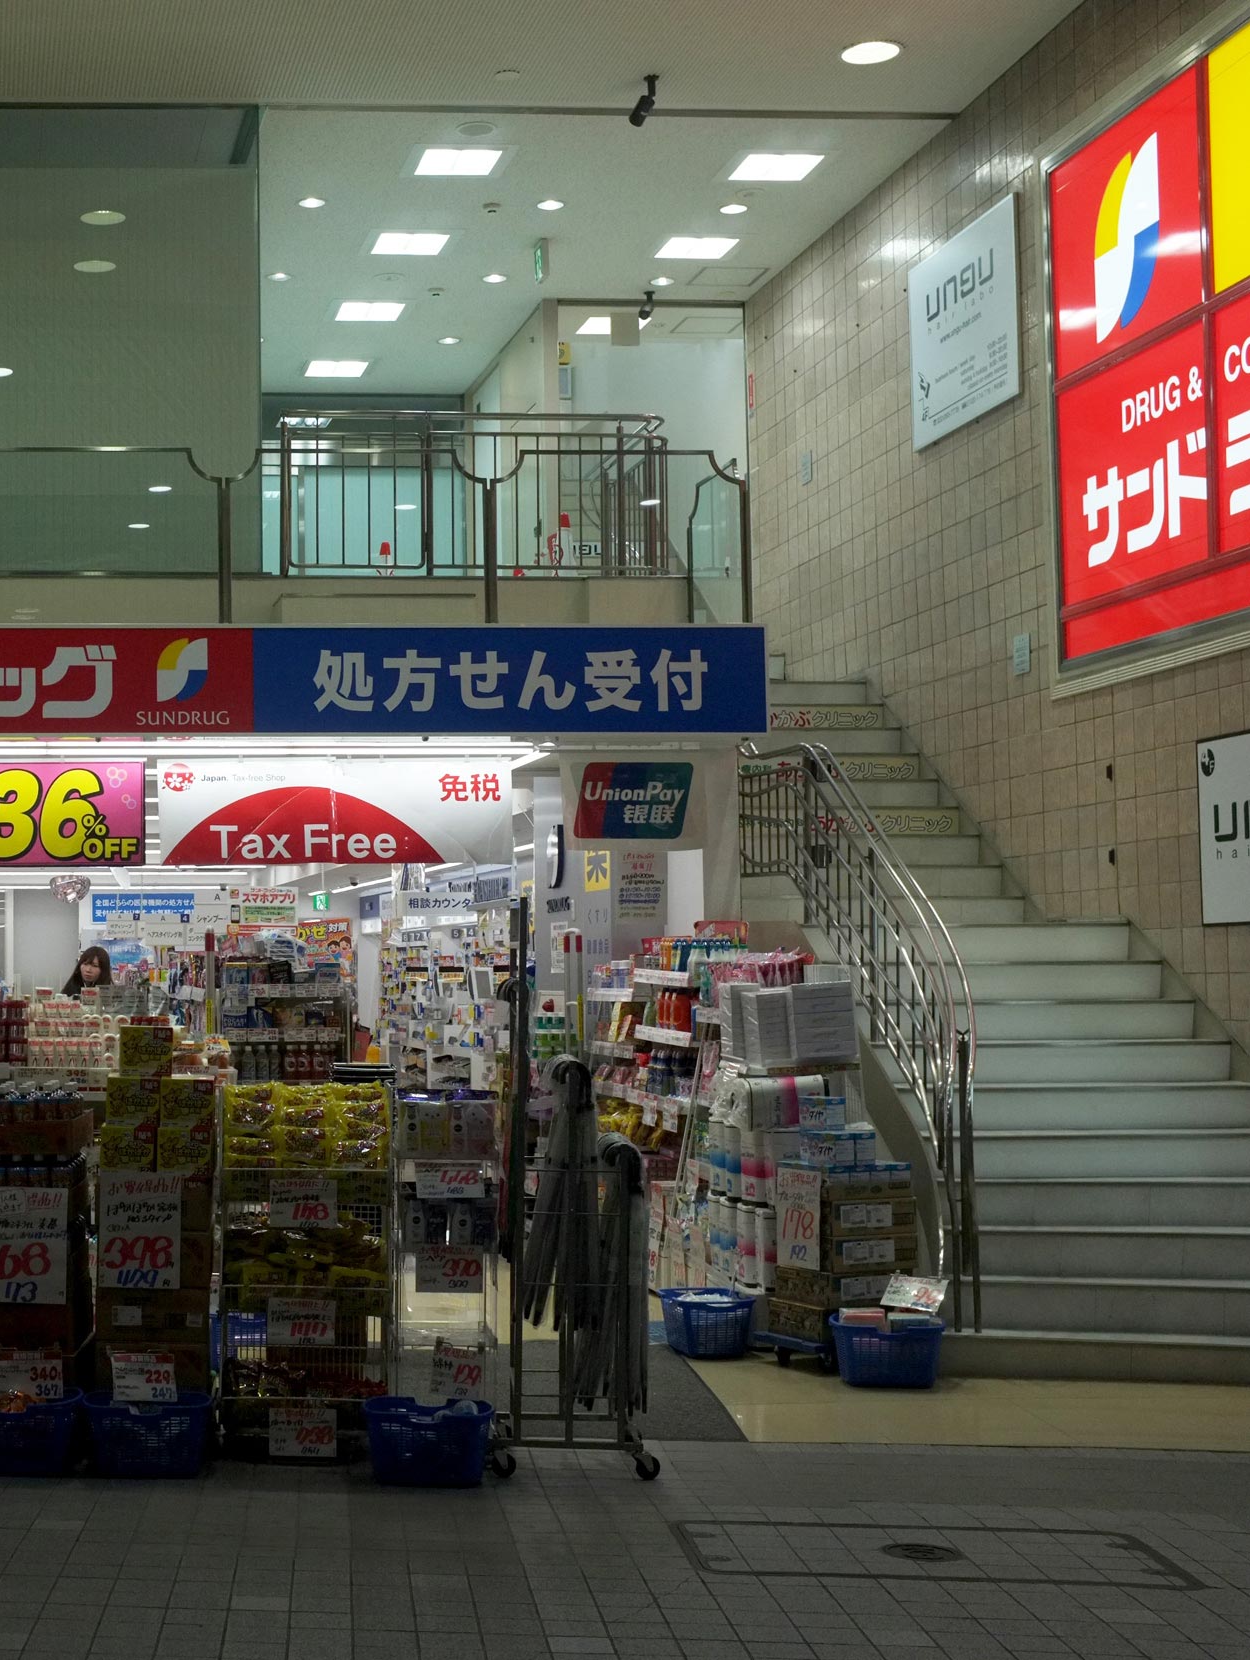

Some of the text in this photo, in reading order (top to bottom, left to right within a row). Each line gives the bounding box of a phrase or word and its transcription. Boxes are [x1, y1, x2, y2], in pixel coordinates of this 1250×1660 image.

[1121, 375, 1181, 433] DRUG
[1187, 366, 1203, 402] &
[312, 648, 709, 713] 処方せん受付
[135, 710, 231, 726] SUNDRUG
[265, 774, 286, 784] Shop
[438, 773, 502, 802] 免税
[584, 781, 686, 808] UnionPay
[623, 804, 675, 824] 银联
[81, 837, 138, 861] OFF
[209, 823, 398, 860] Tax Free
[214, 893, 221, 901] A
[242, 893, 296, 904] スマホアプリ
[782, 1207, 815, 1240] 178
[29, 1366, 58, 1381] 340
[35, 1384, 59, 1397] 367
